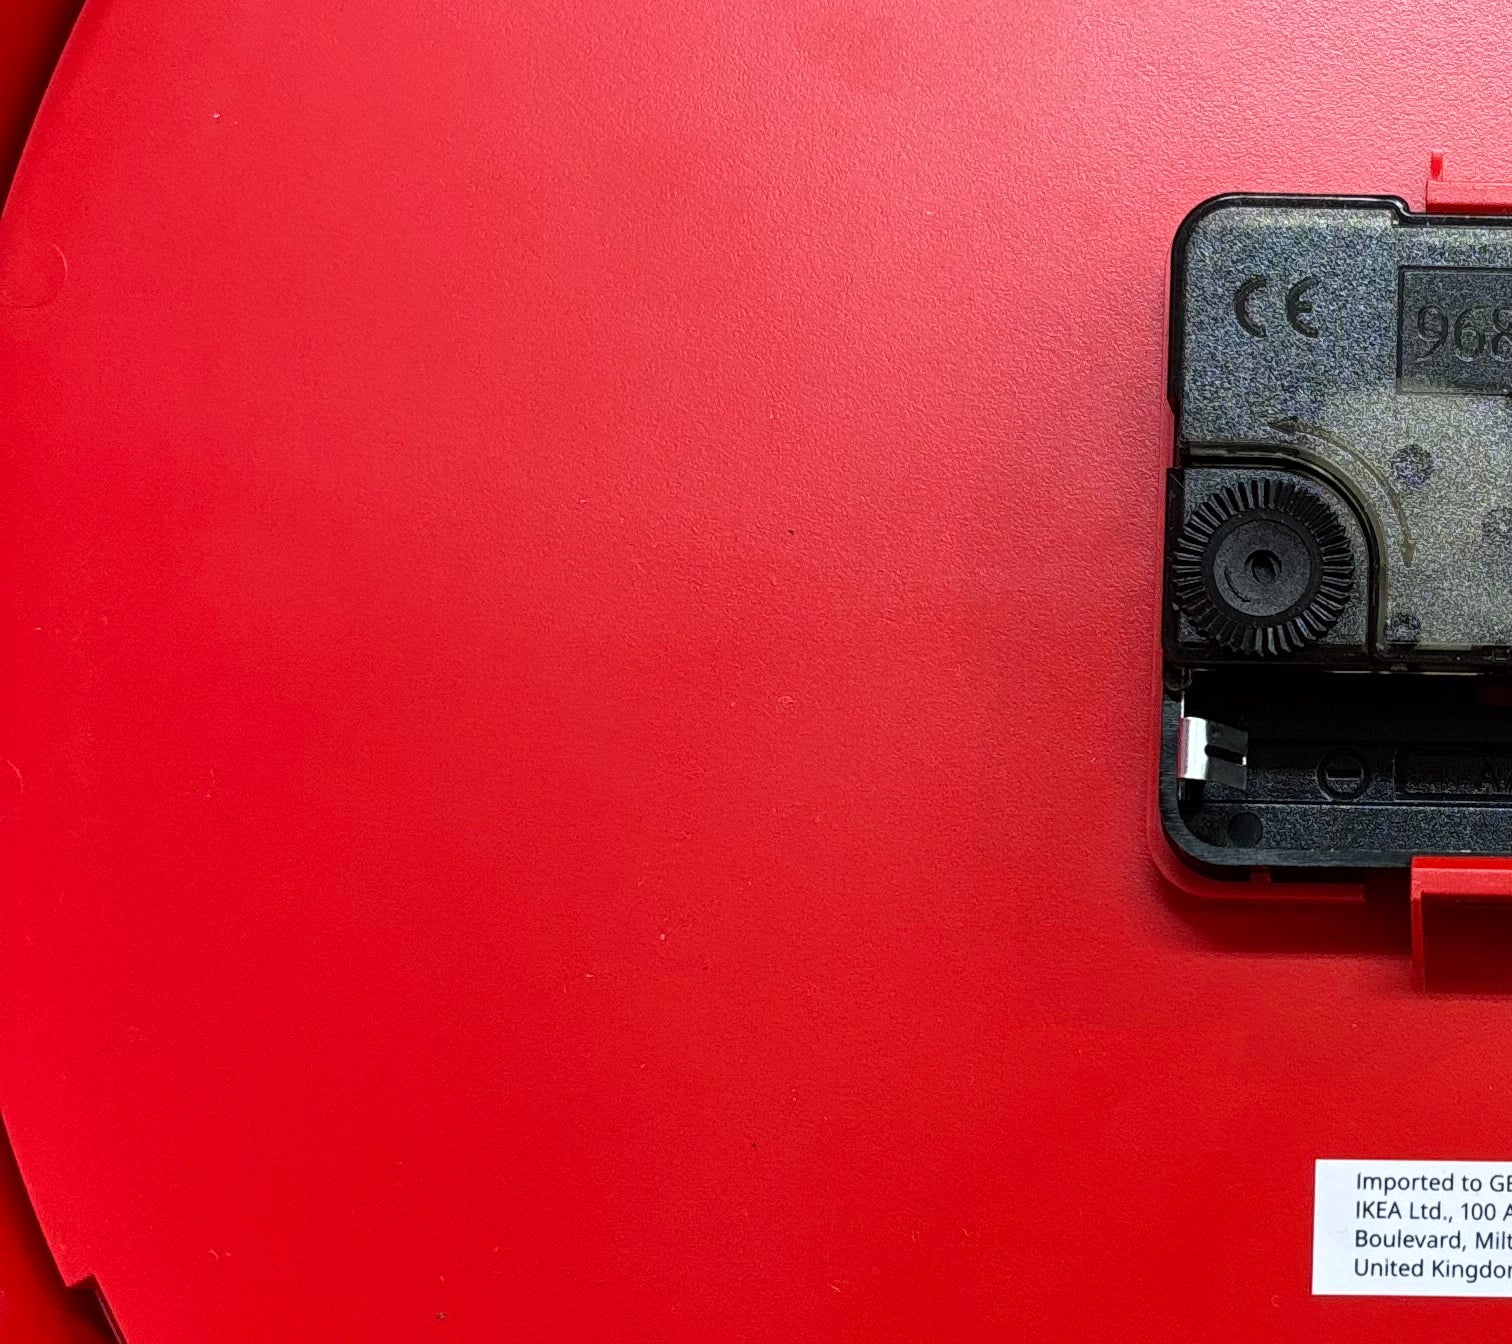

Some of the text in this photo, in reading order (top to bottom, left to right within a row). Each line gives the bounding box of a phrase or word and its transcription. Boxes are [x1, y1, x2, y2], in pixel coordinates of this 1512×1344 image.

[1355, 1171, 1454, 1197] Imported
[1462, 1173, 1482, 1193] to
[1355, 1201, 1402, 1220] IKEA
[1409, 1202, 1453, 1224] Ltd.,
[1460, 1203, 1496, 1221] 100
[1355, 1229, 1467, 1252] Boulevard,
[1354, 1258, 1424, 1278] United
